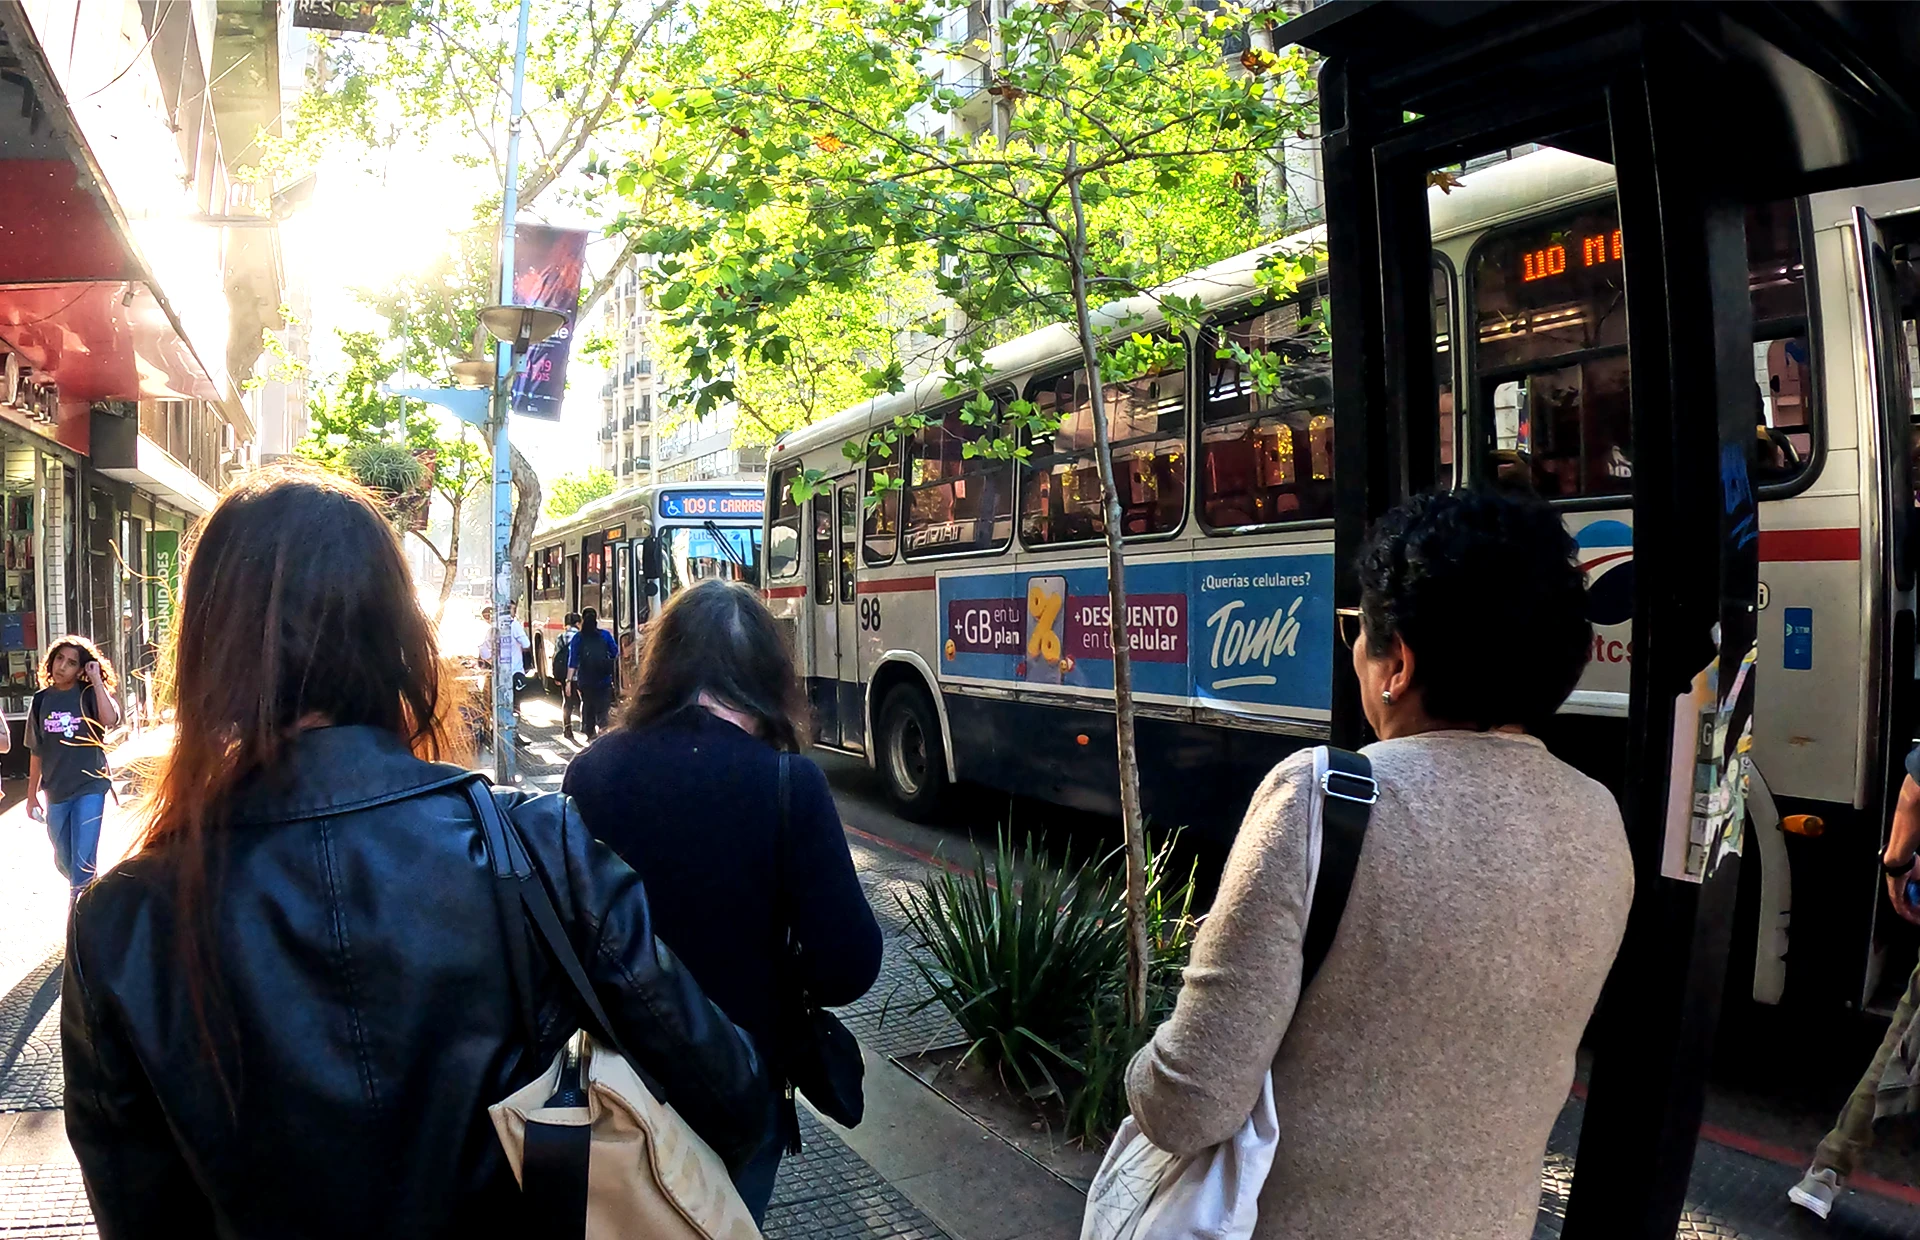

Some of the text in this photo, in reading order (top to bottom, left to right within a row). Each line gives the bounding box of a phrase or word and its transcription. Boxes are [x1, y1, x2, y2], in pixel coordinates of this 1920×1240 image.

[1524, 245, 1566, 281] 110
[683, 498, 707, 514] 109
[709, 499, 720, 513] C.
[1201, 572, 1311, 592] ¿Querías celulares?
[861, 597, 881, 631] 98
[994, 606, 1020, 623] en tu
[994, 626, 1020, 649] plan
[1083, 632, 1099, 648] en
[1125, 628, 1178, 651] elular
[1206, 596, 1303, 669] Tomá
